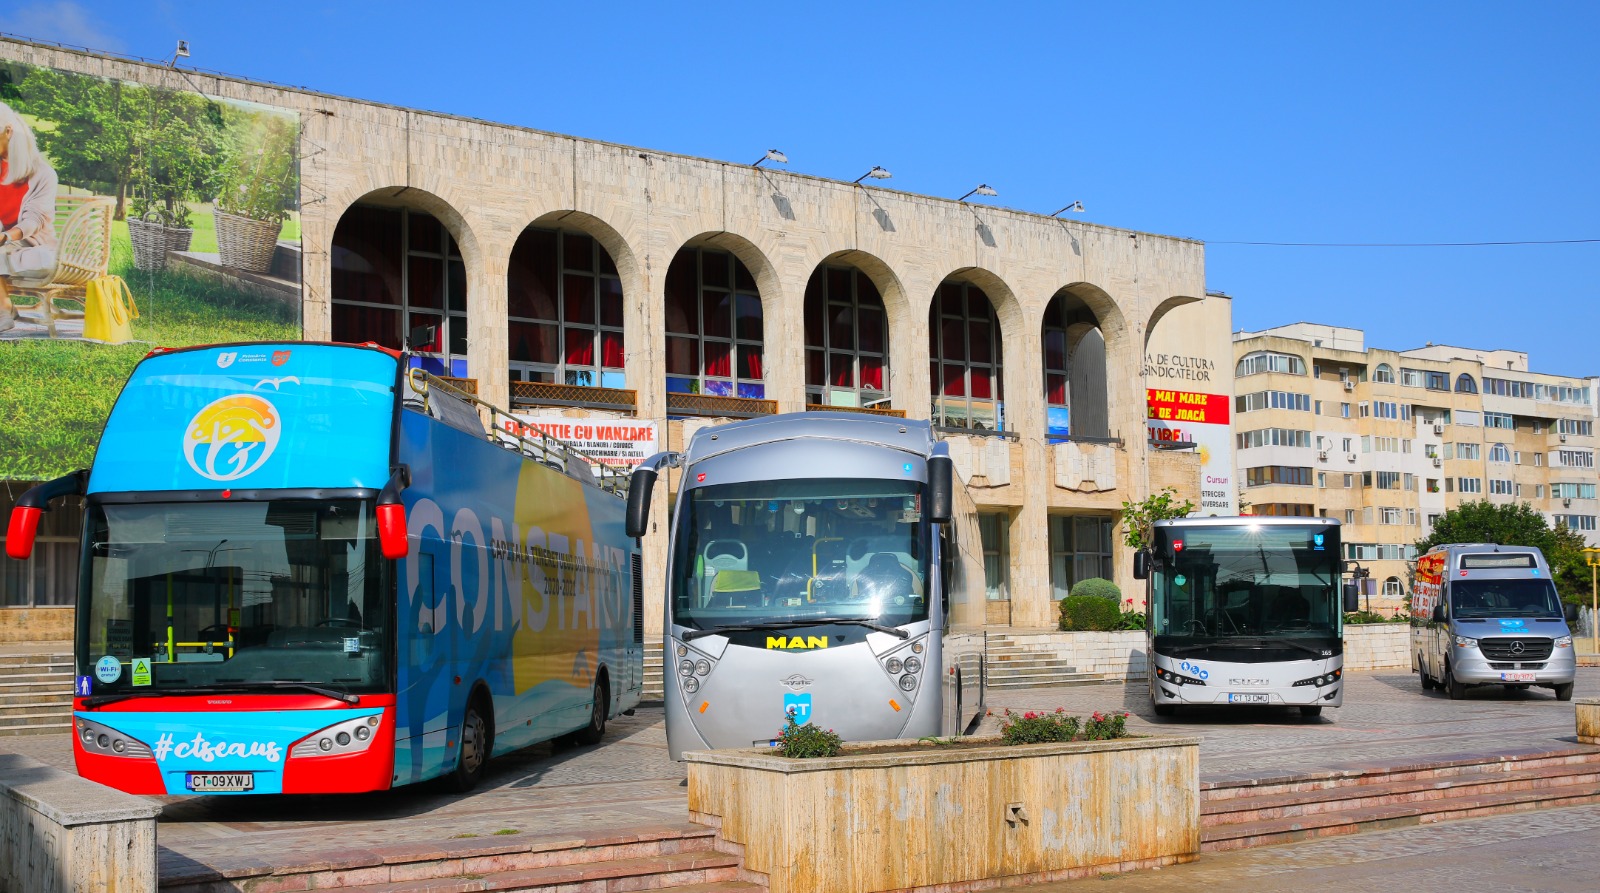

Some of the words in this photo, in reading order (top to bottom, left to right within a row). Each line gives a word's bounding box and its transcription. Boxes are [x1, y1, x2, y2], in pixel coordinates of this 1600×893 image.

[1157, 354, 1168, 366] DE
[1172, 355, 1215, 370] CULTURA
[1155, 391, 1176, 403] MAI
[1179, 393, 1208, 406] MARE
[1158, 407, 1172, 419] DE
[1175, 409, 1206, 422] JOACĂ
[574, 425, 593, 440] CU
[596, 426, 653, 441] VANZARE
[1206, 475, 1229, 484] Cursuri
[1201, 490, 1226, 498] ETRECERI
[490, 537, 530, 564] CAPITALA
[766, 635, 828, 649] MAN
[1228, 678, 1269, 686] ISUZU
[1233, 694, 1242, 702] CT
[785, 703, 810, 716] CT
[154, 732, 283, 762] #ctseaus
[193, 775, 208, 787] CT
